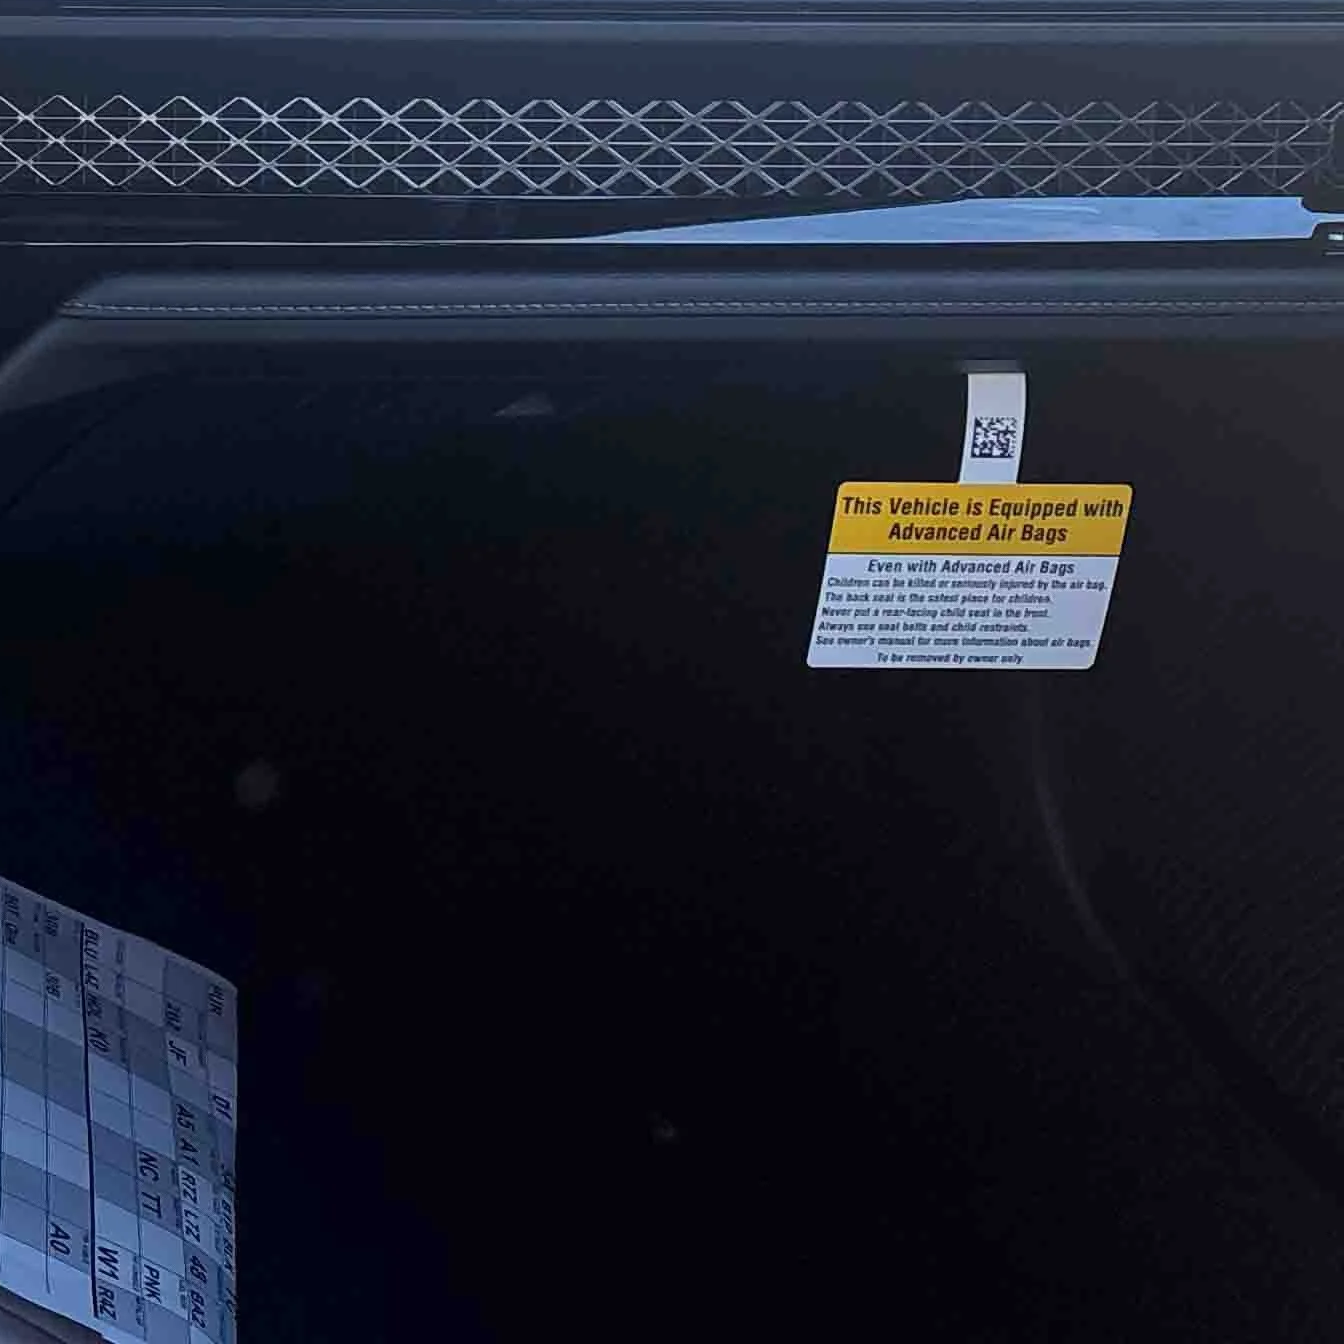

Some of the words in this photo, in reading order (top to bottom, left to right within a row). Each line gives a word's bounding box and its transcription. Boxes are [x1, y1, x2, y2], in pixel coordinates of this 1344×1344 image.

[842, 497, 882, 515] This
[889, 497, 960, 516] Vehicle
[965, 498, 983, 516] is
[988, 498, 1077, 520] Equipped
[1083, 500, 1123, 517] with
[888, 523, 982, 541] Advanced
[986, 523, 1017, 541] Air
[1021, 524, 1068, 545] Bags
[867, 559, 902, 573] Even
[907, 559, 937, 574] with
[941, 560, 1010, 574] Advanced
[1014, 561, 1035, 574] Air
[1040, 561, 1075, 576] Bags
[827, 577, 871, 587] Children
[872, 579, 890, 587] can
[893, 577, 905, 587] be
[908, 577, 936, 588] killed
[938, 579, 949, 588] or
[951, 579, 996, 590] seriously
[1000, 580, 1034, 590] injured
[1038, 580, 1048, 590] by
[1051, 580, 1066, 589] the
[1070, 580, 1084, 589] air
[825, 592, 843, 601] The
[846, 592, 869, 601] back
[872, 593, 894, 602] seat
[897, 592, 906, 602] is
[909, 593, 925, 602] the
[927, 593, 960, 602] safest
[962, 594, 988, 604] place
[992, 594, 1005, 604] for
[822, 608, 851, 617] Never
[854, 608, 870, 618] put
[882, 608, 938, 619] rear-facing
[940, 608, 966, 617] child
[968, 609, 990, 617] seat
[992, 608, 1002, 617] in
[1006, 608, 1023, 618] the
[818, 622, 854, 632] Always
[878, 622, 900, 631] seat
[903, 622, 927, 631] belts
[930, 623, 948, 631] and
[952, 623, 976, 631] child
[816, 636, 834, 645] See
[878, 636, 915, 645] manual
[918, 637, 931, 645] for
[934, 638, 960, 646] more
[962, 638, 1018, 646] information
[1021, 638, 1049, 647] about
[1051, 638, 1065, 647] air
[877, 653, 887, 662] To
[891, 653, 903, 662] be
[906, 653, 951, 662] removed
[953, 654, 964, 664] by
[967, 655, 997, 663] owner
